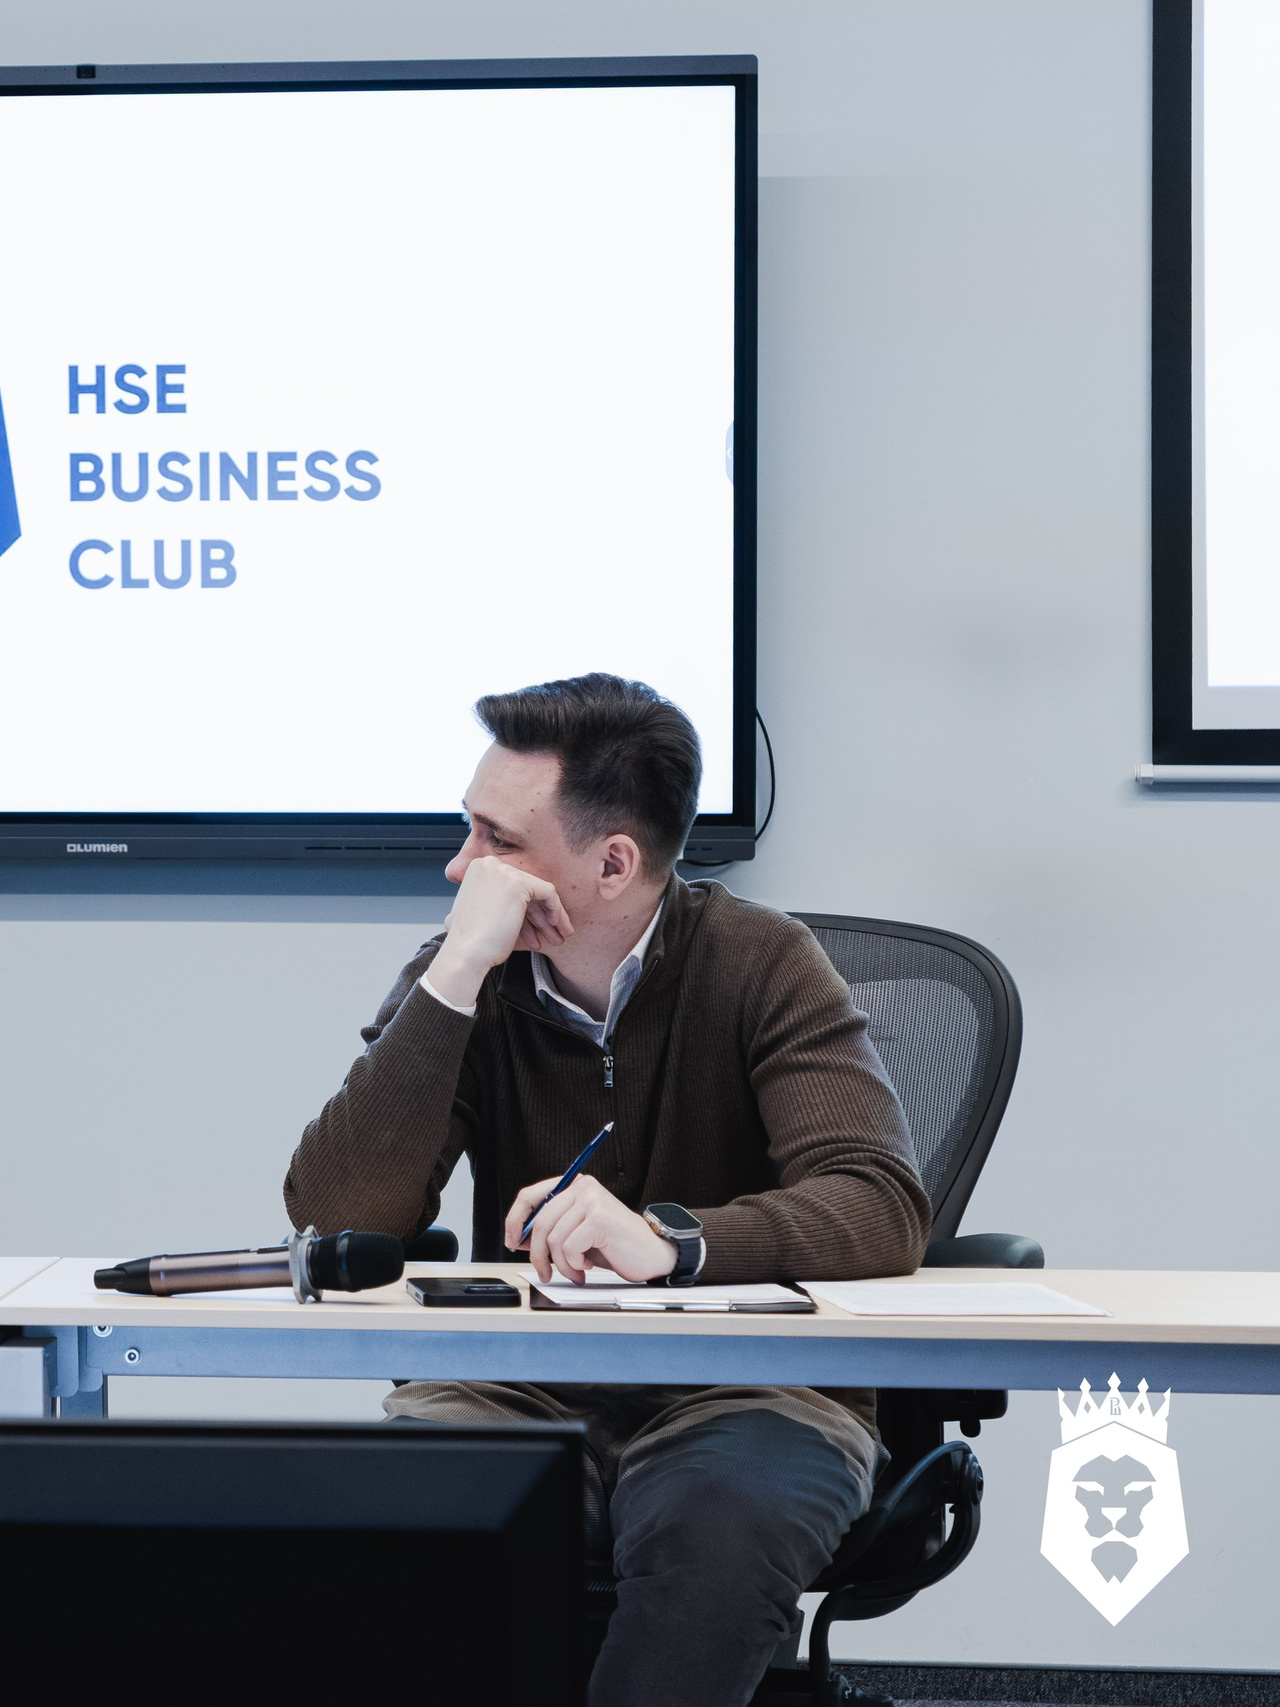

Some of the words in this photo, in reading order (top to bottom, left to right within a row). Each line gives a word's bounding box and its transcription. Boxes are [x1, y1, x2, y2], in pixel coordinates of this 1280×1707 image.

[67, 362, 188, 416] HSE
[68, 449, 382, 503] BUSINESS
[68, 538, 238, 591] CLUB
